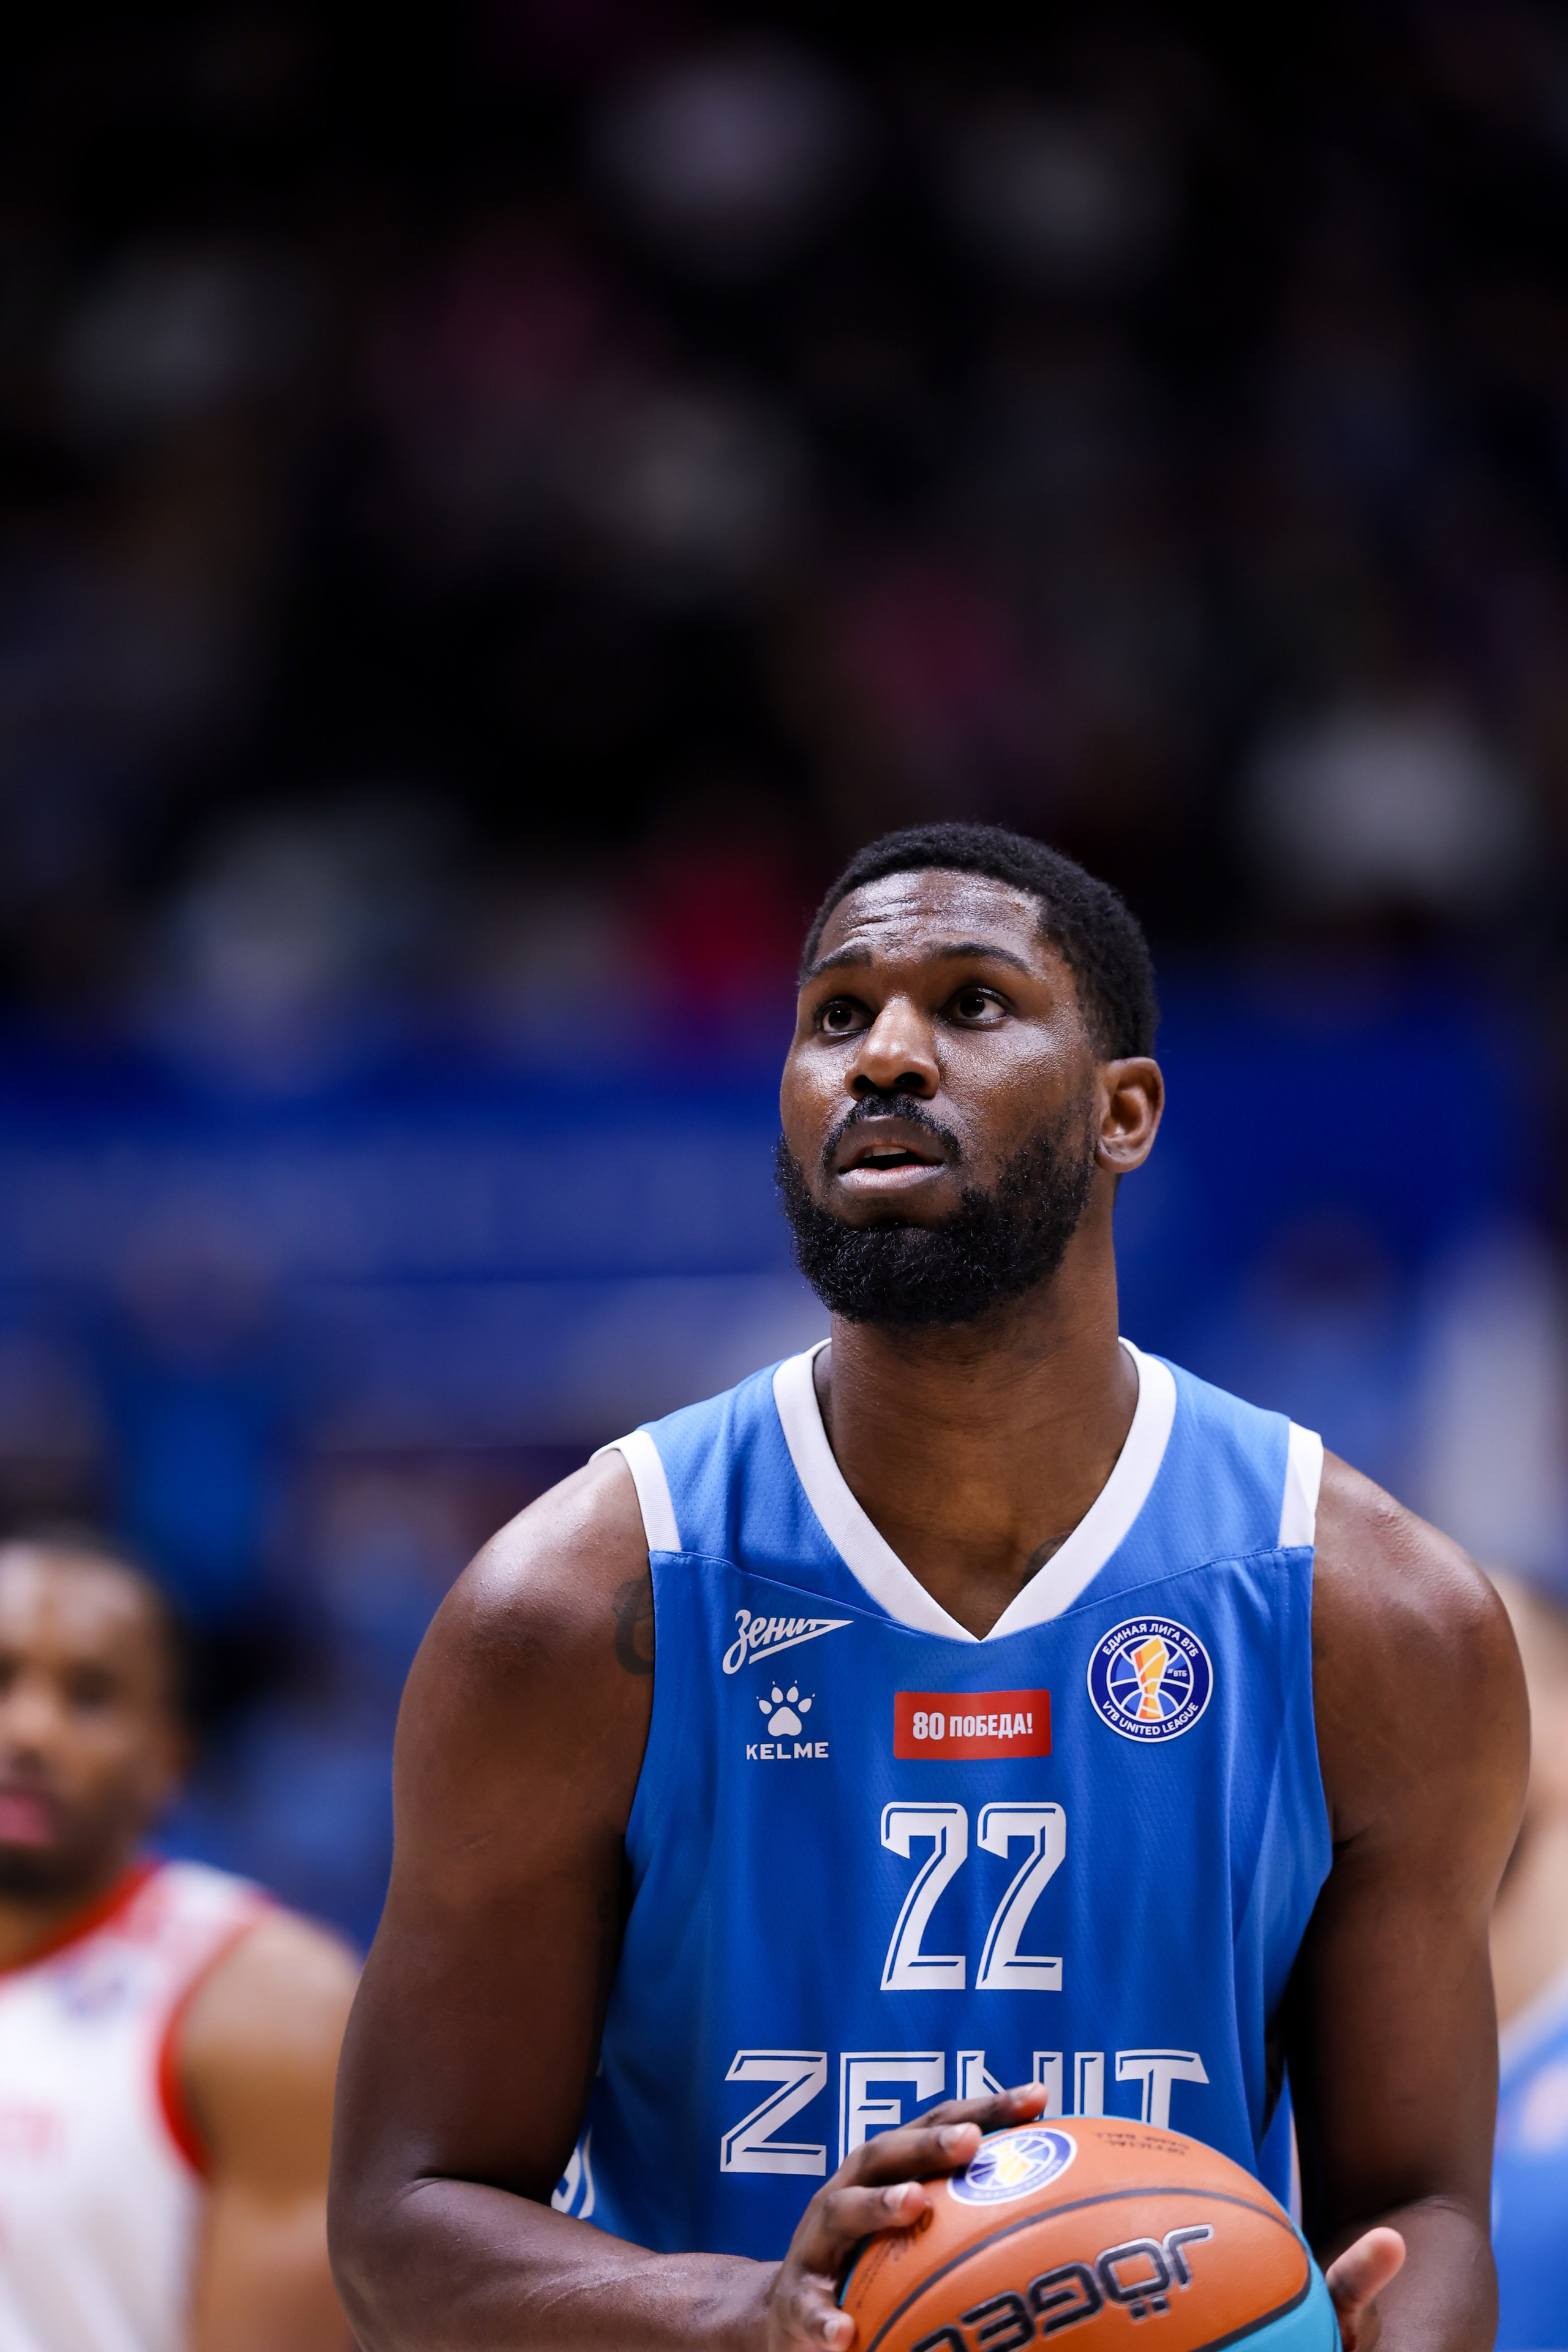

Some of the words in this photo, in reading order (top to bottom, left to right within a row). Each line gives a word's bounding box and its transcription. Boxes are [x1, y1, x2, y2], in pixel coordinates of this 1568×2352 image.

[1102, 1623, 1147, 1656] ЕДИНАЯ
[1149, 1623, 1181, 1642] ЛИГА
[1180, 1638, 1199, 1657] ВТБ
[913, 1712, 945, 1740] 80
[949, 1713, 1033, 1740] ПОБЕДА!
[1102, 1700, 1120, 1721] VTB
[1118, 1717, 1161, 1735] UNITED
[1163, 1702, 1199, 1733] LEAGUE
[746, 1742, 829, 1760] KELME
[880, 1801, 1066, 1991] 22
